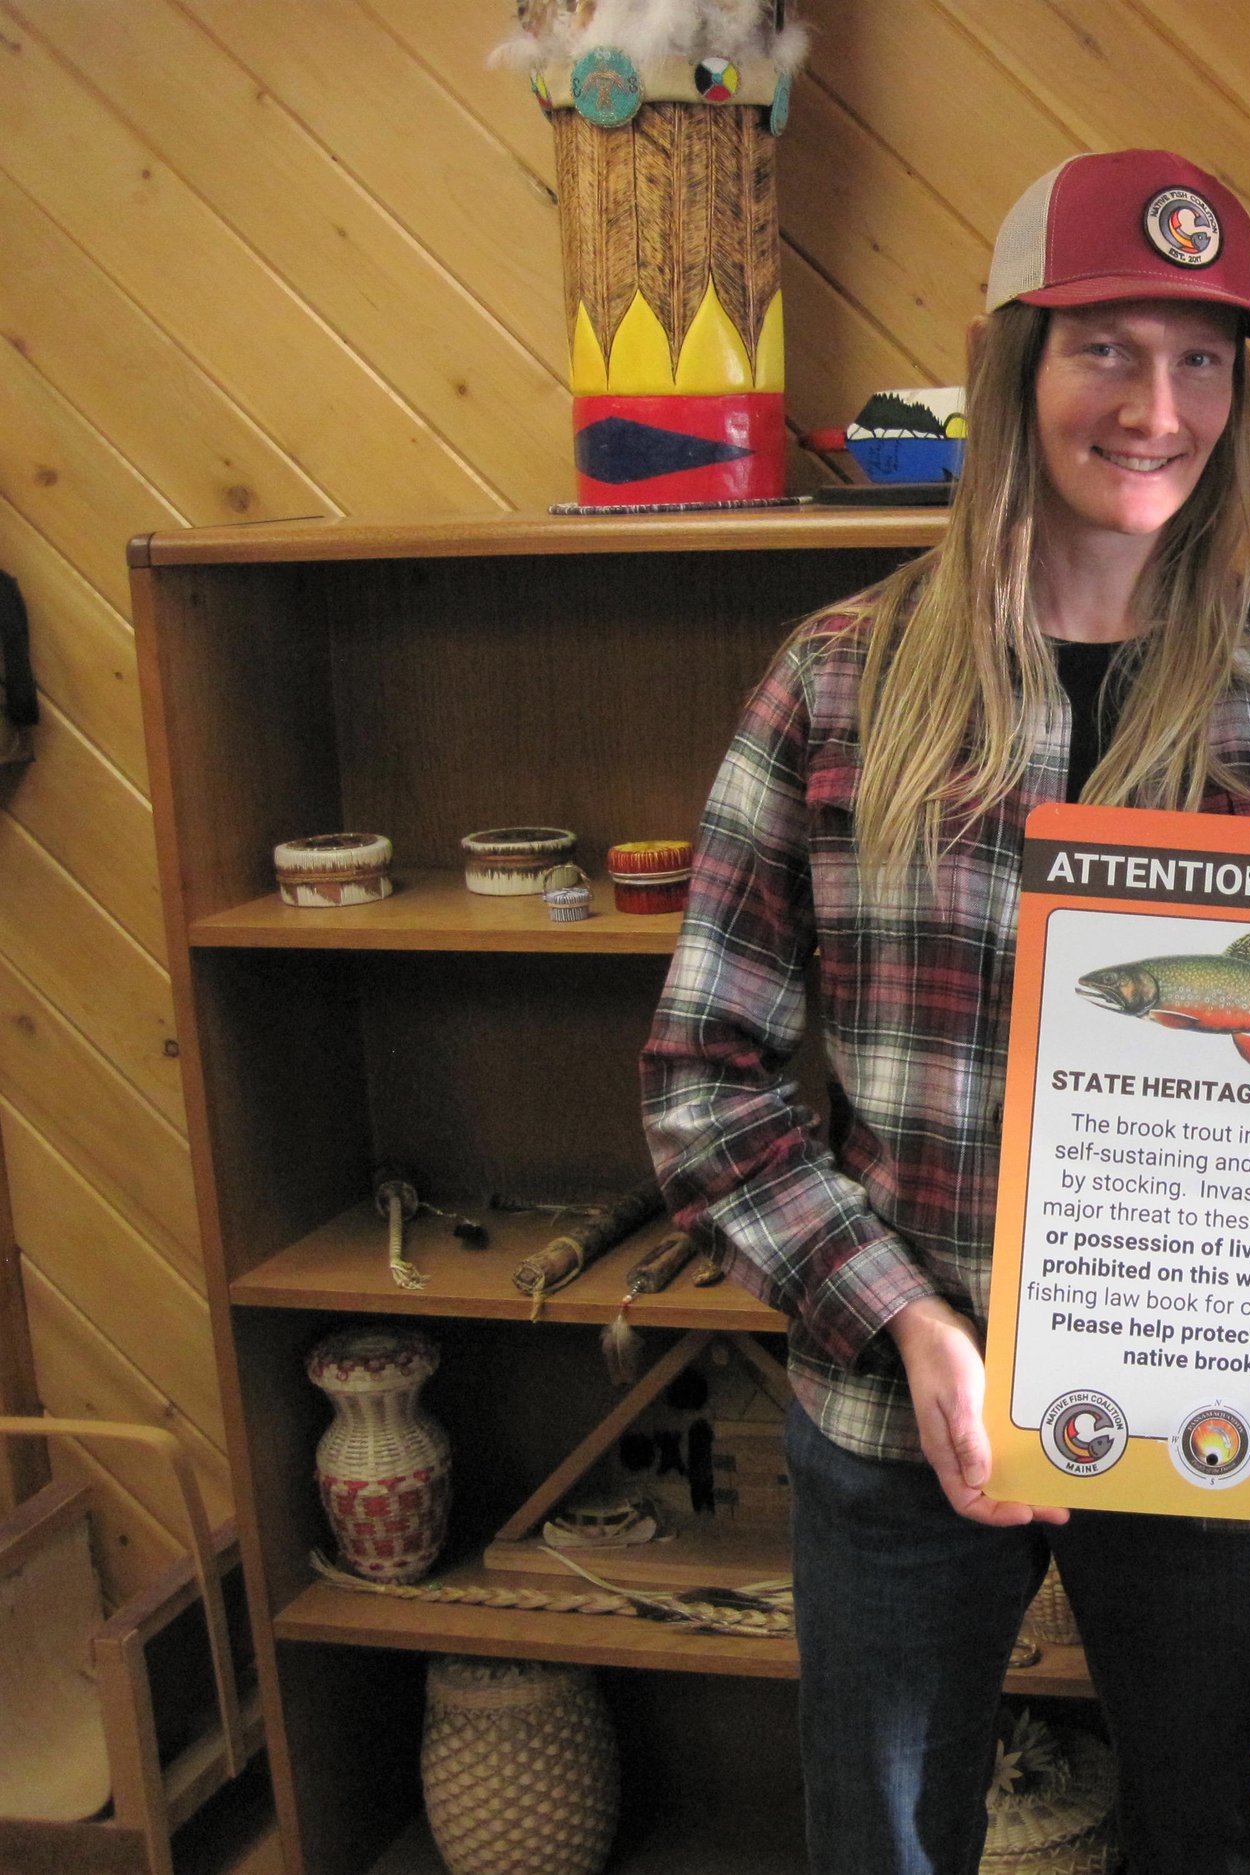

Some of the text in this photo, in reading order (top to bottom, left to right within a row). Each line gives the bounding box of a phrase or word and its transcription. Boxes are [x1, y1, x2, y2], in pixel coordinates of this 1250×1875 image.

[1150, 191, 1218, 234] NATIVE FISH COALITION
[1051, 1070, 1136, 1096] STATE
[1071, 1113, 1110, 1134] The
[1117, 1115, 1176, 1139] brook
[1182, 1123, 1232, 1143] trout
[1055, 1141, 1208, 1174] self-sustaining
[1062, 1169, 1086, 1194] by
[1092, 1174, 1186, 1201] stocking.
[1043, 1199, 1104, 1222] major
[1109, 1202, 1171, 1224] threat
[1177, 1208, 1198, 1226] to
[1046, 1230, 1068, 1245] or
[1074, 1232, 1194, 1255] possession
[1201, 1237, 1224, 1256] of
[1042, 1256, 1151, 1280] prohibited
[1157, 1267, 1183, 1282] on
[1190, 1265, 1229, 1286] this
[1027, 1281, 1097, 1309] fishing
[1105, 1287, 1140, 1308] law
[1147, 1290, 1198, 1312] book
[1205, 1294, 1235, 1314] for
[1051, 1312, 1123, 1335] Please
[1129, 1317, 1175, 1343] help
[1123, 1348, 1188, 1369] native
[1046, 1393, 1124, 1430] NATIVE FISH COALITION
[1065, 1462, 1099, 1473] MAINE
